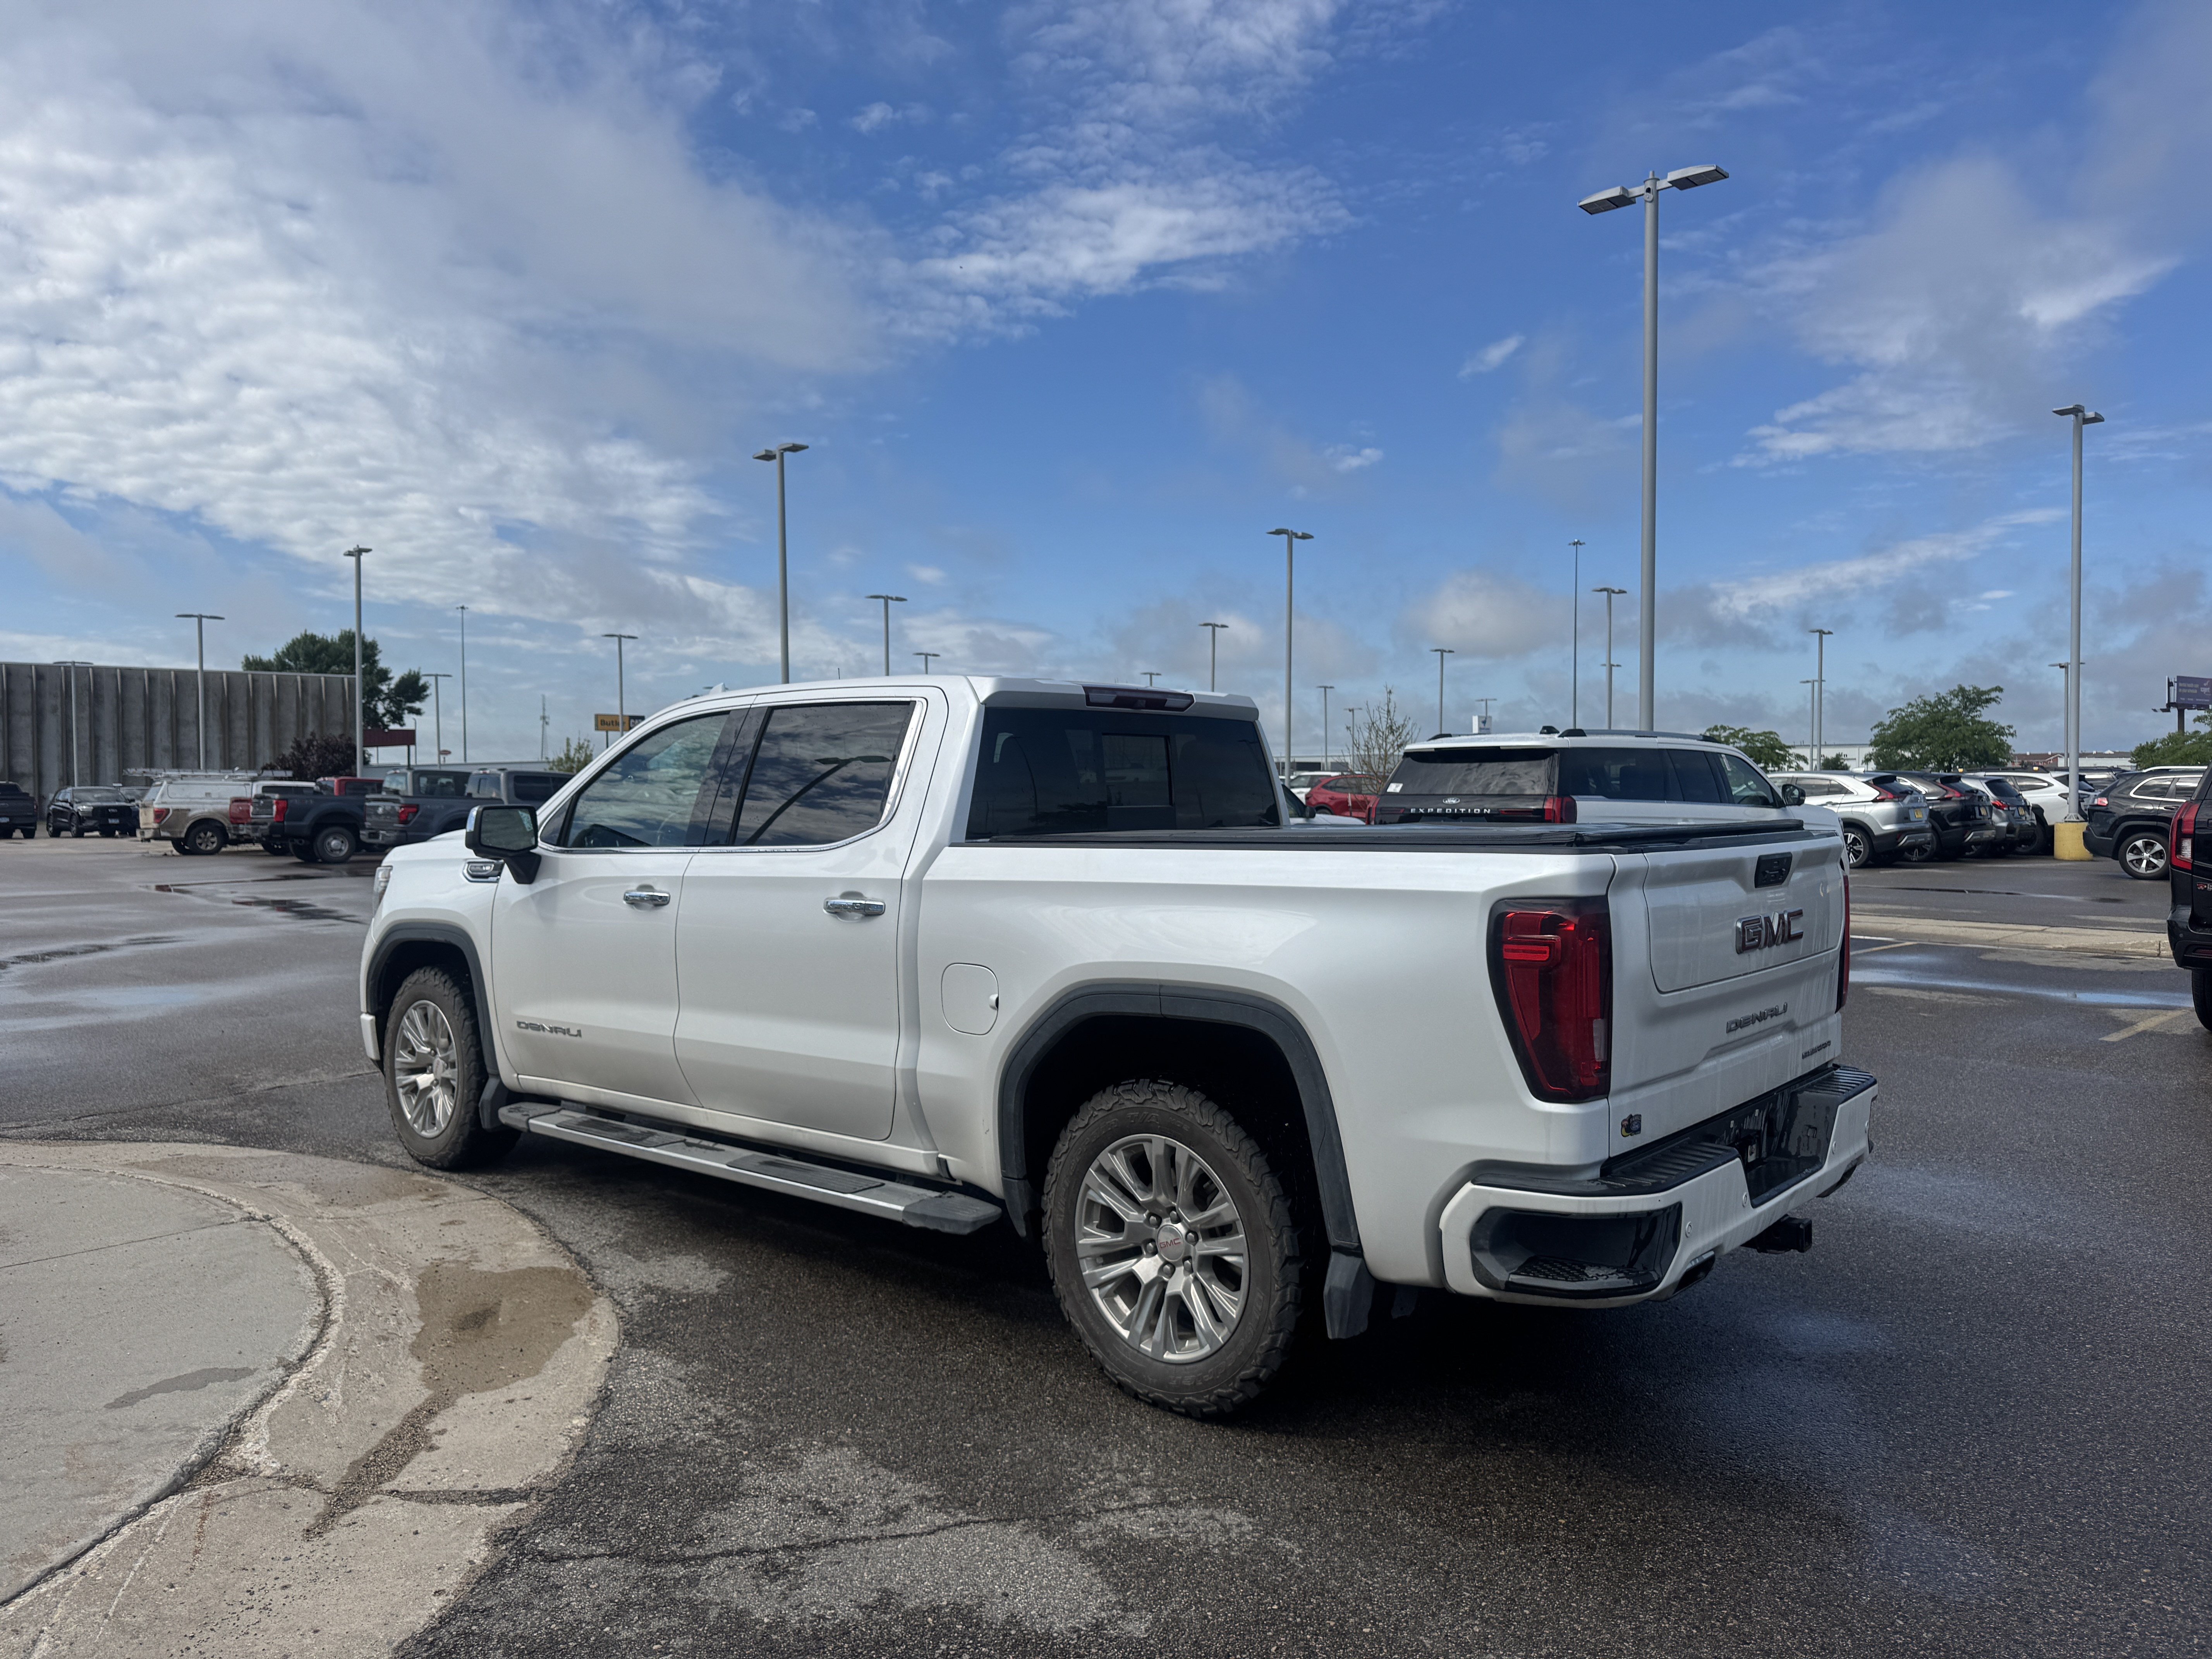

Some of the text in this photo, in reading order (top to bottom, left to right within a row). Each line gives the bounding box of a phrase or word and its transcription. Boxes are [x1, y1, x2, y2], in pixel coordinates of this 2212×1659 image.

[1736, 907, 1803, 955] GMC
[1726, 1002, 1788, 1033] DENALI
[517, 1020, 582, 1038] DENALI
[1126, 1112, 1159, 1124] T/A
[1159, 1237, 1181, 1248] GMC
